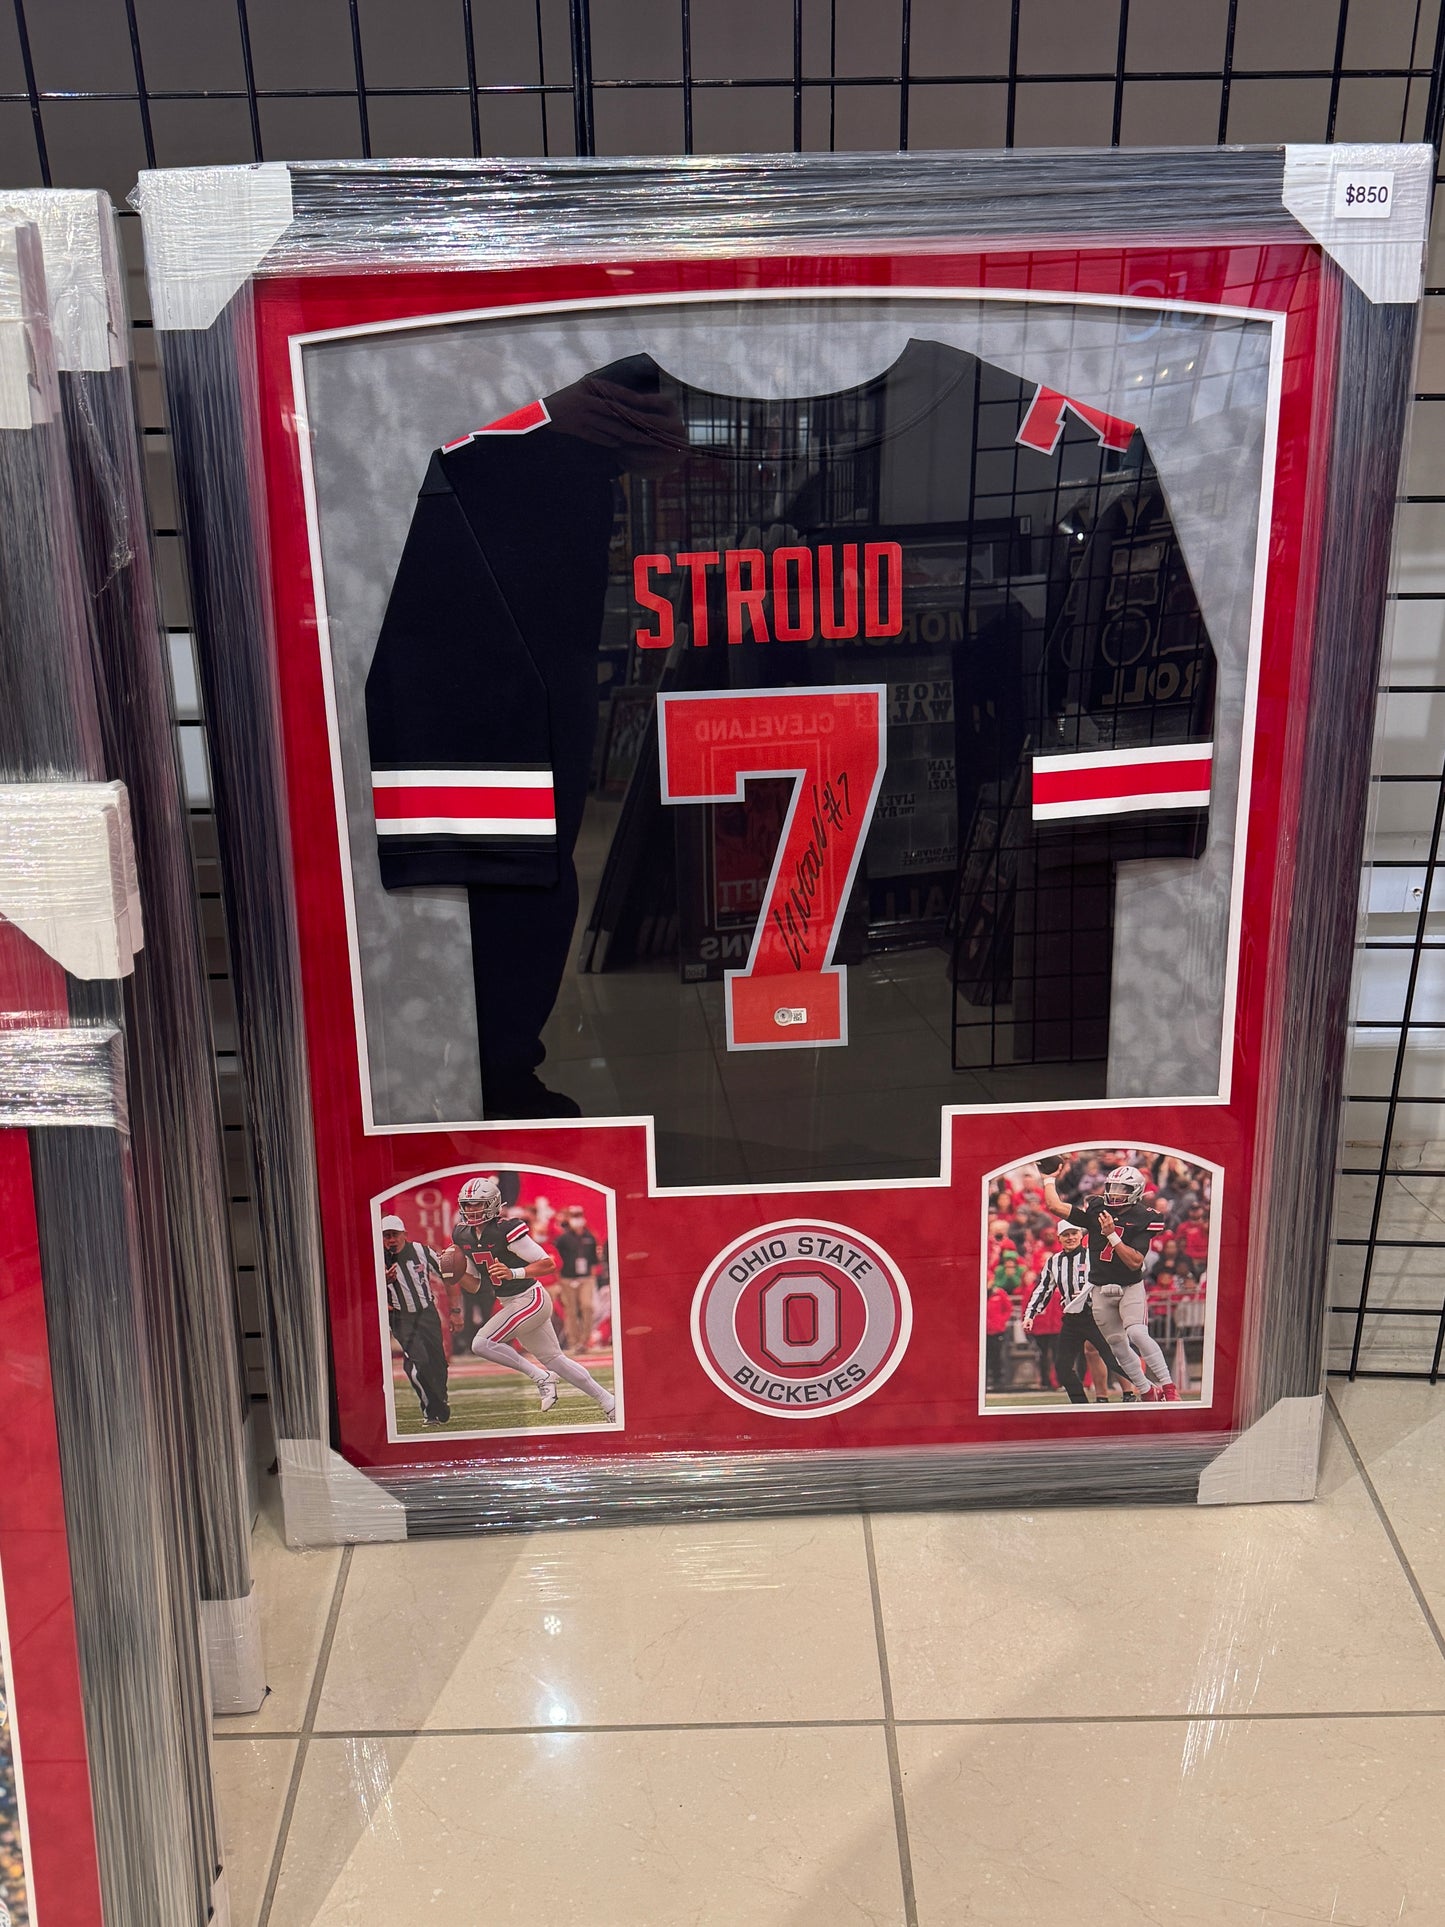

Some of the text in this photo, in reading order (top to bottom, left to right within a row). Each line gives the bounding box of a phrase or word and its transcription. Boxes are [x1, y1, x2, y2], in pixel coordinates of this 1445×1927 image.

[1345, 183, 1388, 206] $850
[633, 541, 903, 650] STROUD
[656, 684, 889, 1052] 7
[728, 1236, 873, 1283] OHIO STATE
[759, 1271, 841, 1368] O
[733, 1363, 866, 1403] BUCKEYES
